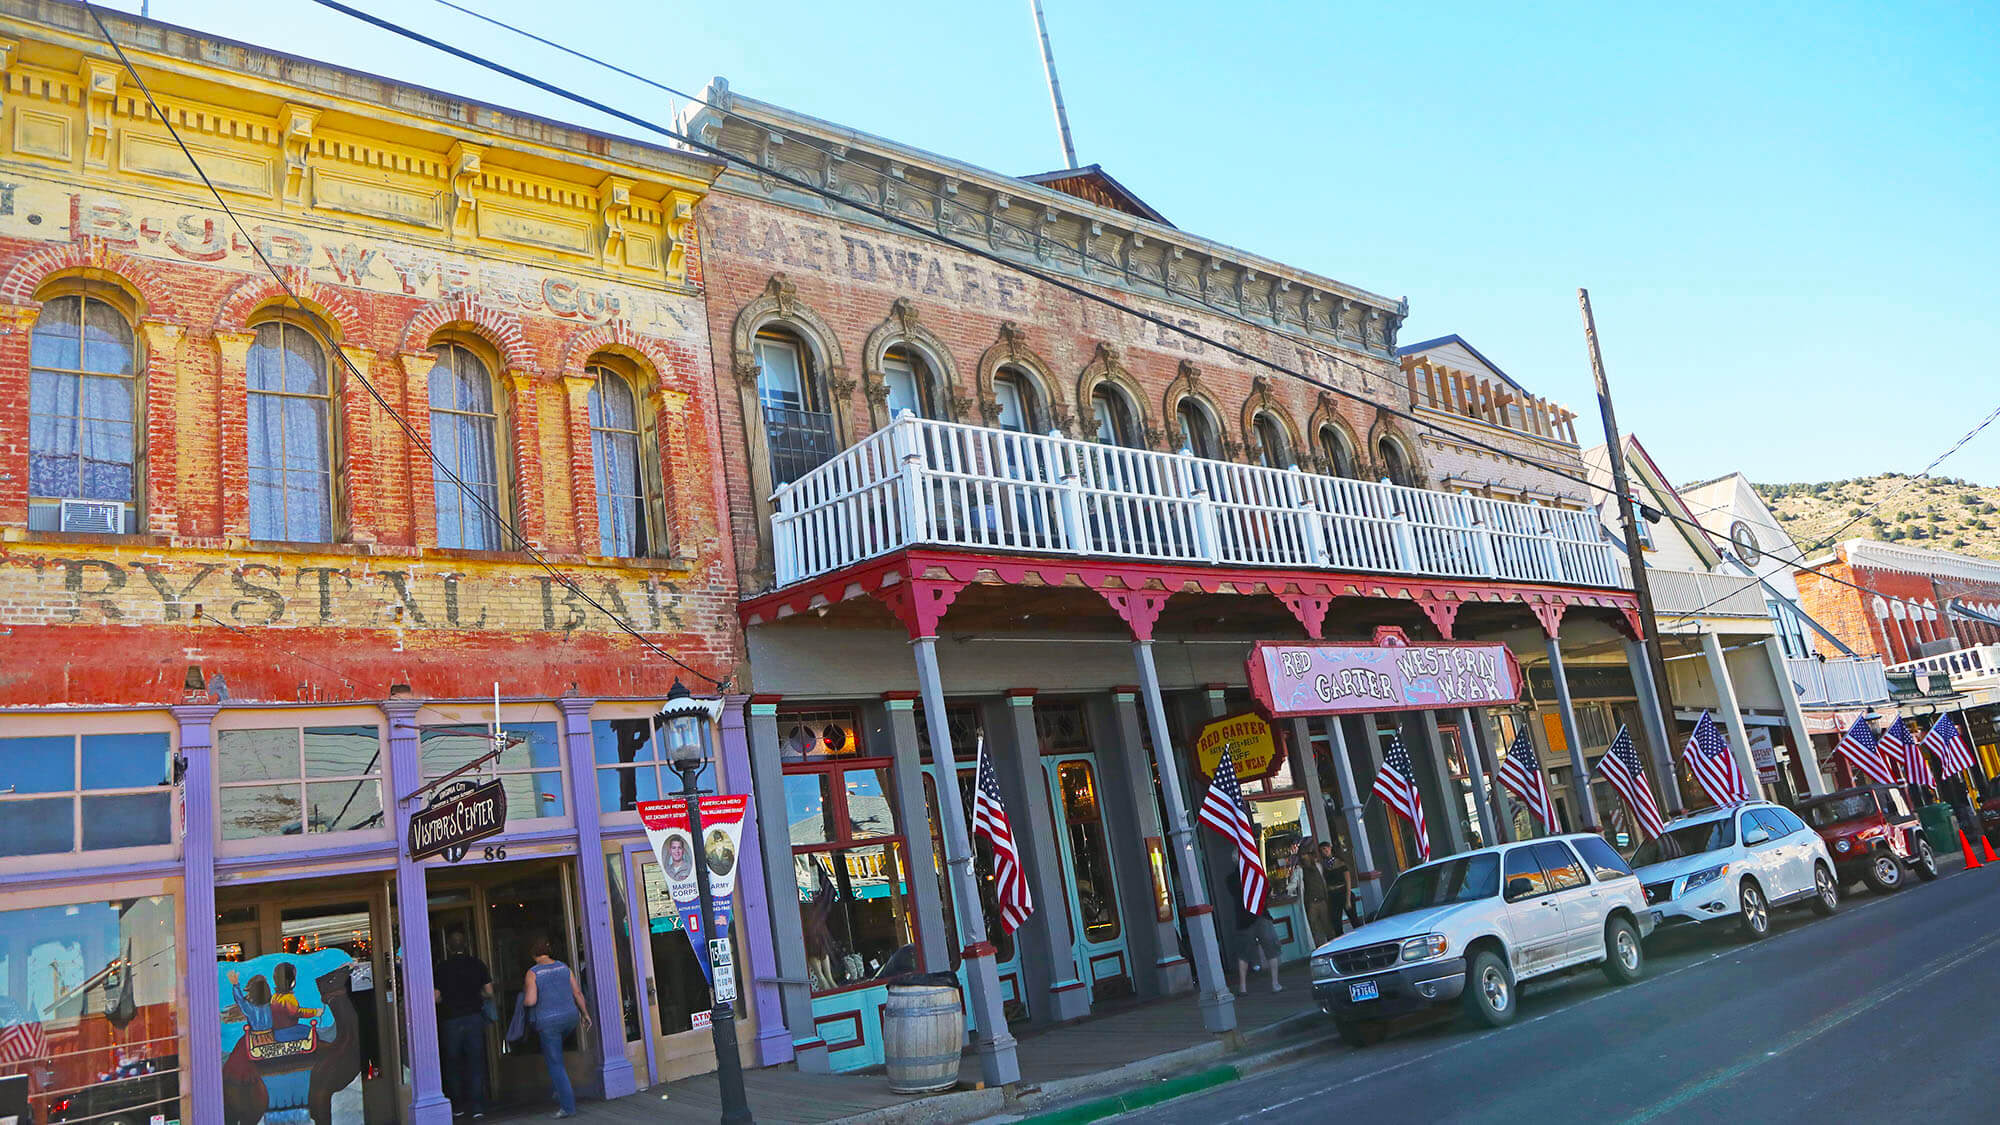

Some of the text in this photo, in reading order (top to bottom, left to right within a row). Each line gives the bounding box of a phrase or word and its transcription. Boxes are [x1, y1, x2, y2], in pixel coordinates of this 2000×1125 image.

[539, 575, 686, 632] BAR
[1281, 651, 1312, 680] RED
[1396, 648, 1497, 682] WESTERN
[1314, 667, 1398, 704] GARTER
[1436, 675, 1502, 703] WEAR
[1201, 721, 1266, 752] RED GARTER
[414, 813, 457, 849] VISITOR'S
[456, 799, 495, 835] CENTER
[484, 845, 507, 861] 86
[672, 882, 697, 890] MARINE
[672, 889, 698, 897] CORPS
[711, 882, 730, 890] ARMY
[693, 1011, 712, 1022] ATM
